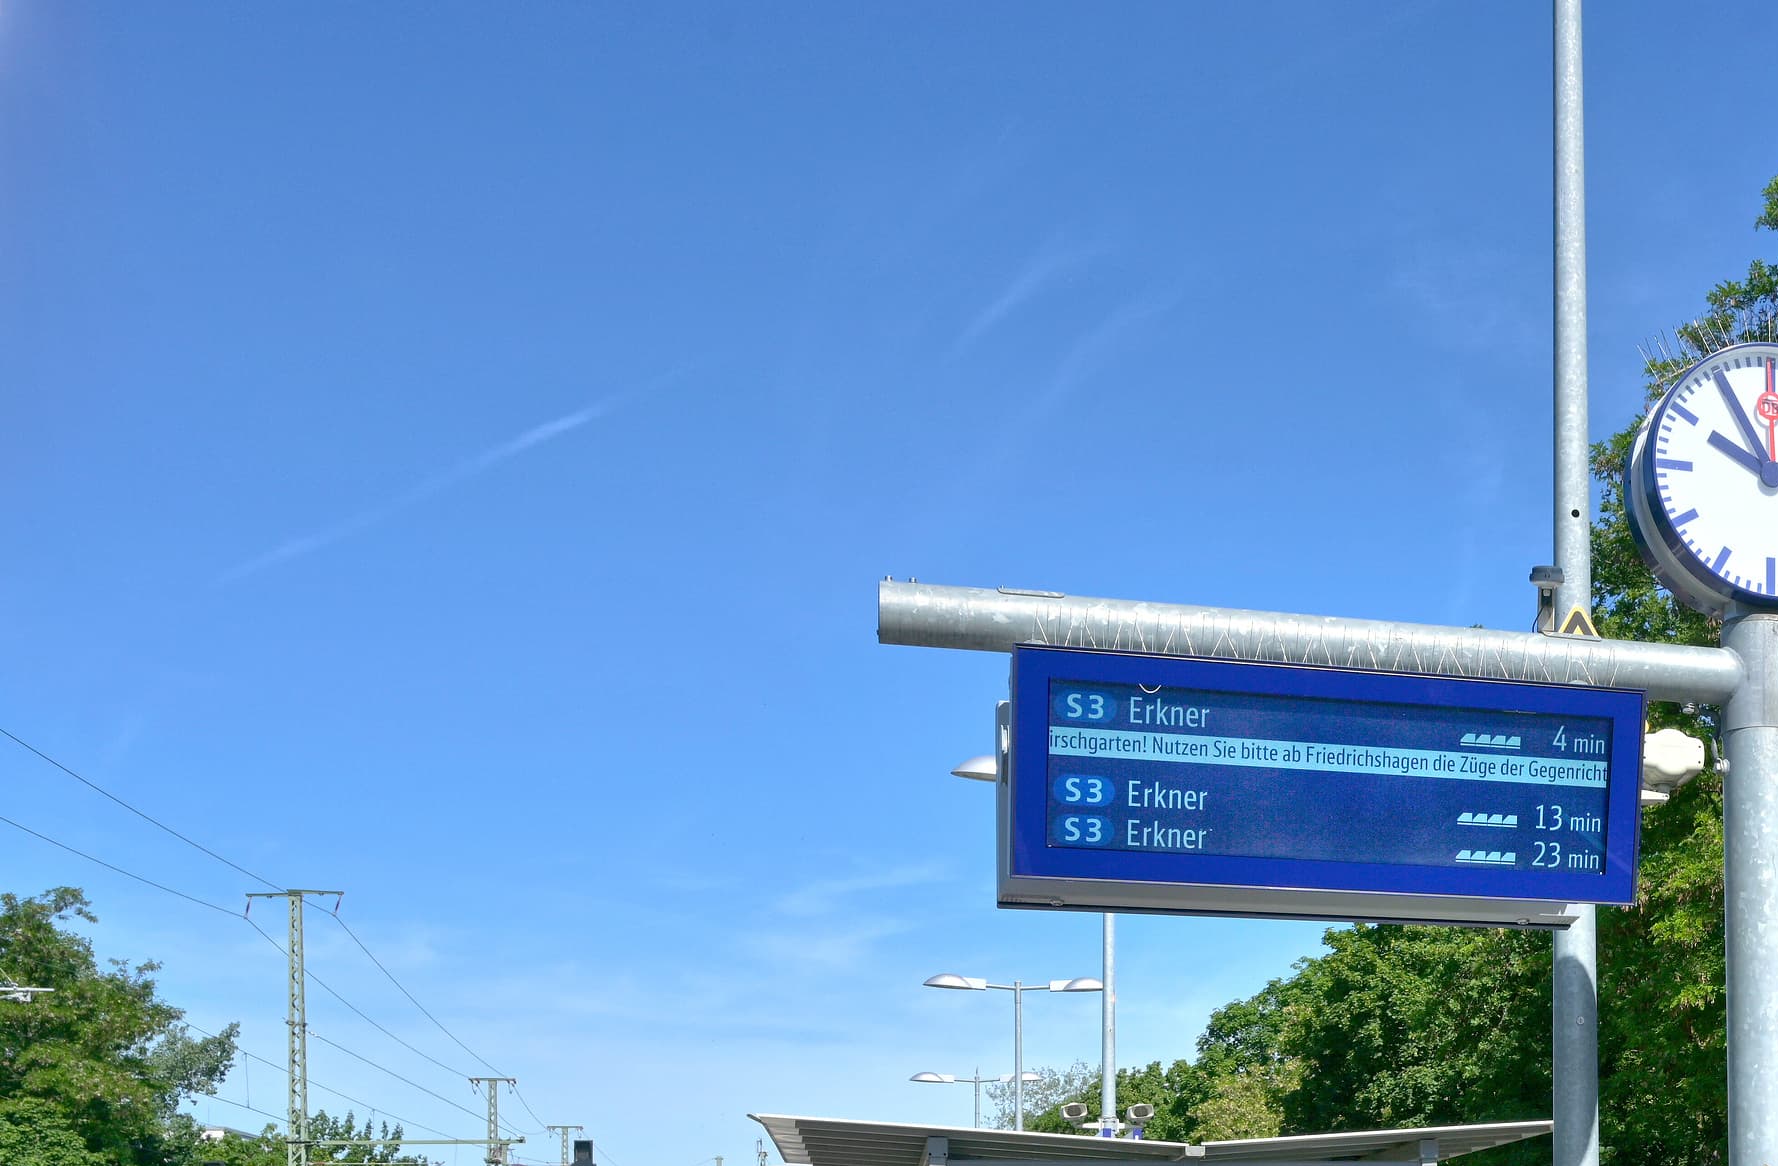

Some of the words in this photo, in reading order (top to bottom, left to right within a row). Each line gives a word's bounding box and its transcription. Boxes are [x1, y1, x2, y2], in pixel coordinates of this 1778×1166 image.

[1130, 696, 1210, 728] Erkner
[1552, 725, 1567, 751] 4
[1574, 734, 1605, 754] min
[1050, 730, 1147, 754] irschgarten!
[1153, 736, 1208, 757] Nutzen
[1213, 740, 1236, 759] Sie
[1242, 741, 1278, 761] bitte
[1283, 745, 1301, 762] ab
[1306, 746, 1428, 773] Friedrichshagen
[1433, 754, 1455, 772] die
[1460, 755, 1496, 778] Züge
[1500, 758, 1524, 776] der
[1528, 760, 1608, 782] Gegenricht
[1128, 780, 1208, 810] Erkner
[1535, 804, 1562, 830] 13
[1570, 813, 1601, 833] min
[1127, 820, 1207, 849] Erkner
[1532, 841, 1561, 868] 23
[1568, 850, 1599, 870] min
